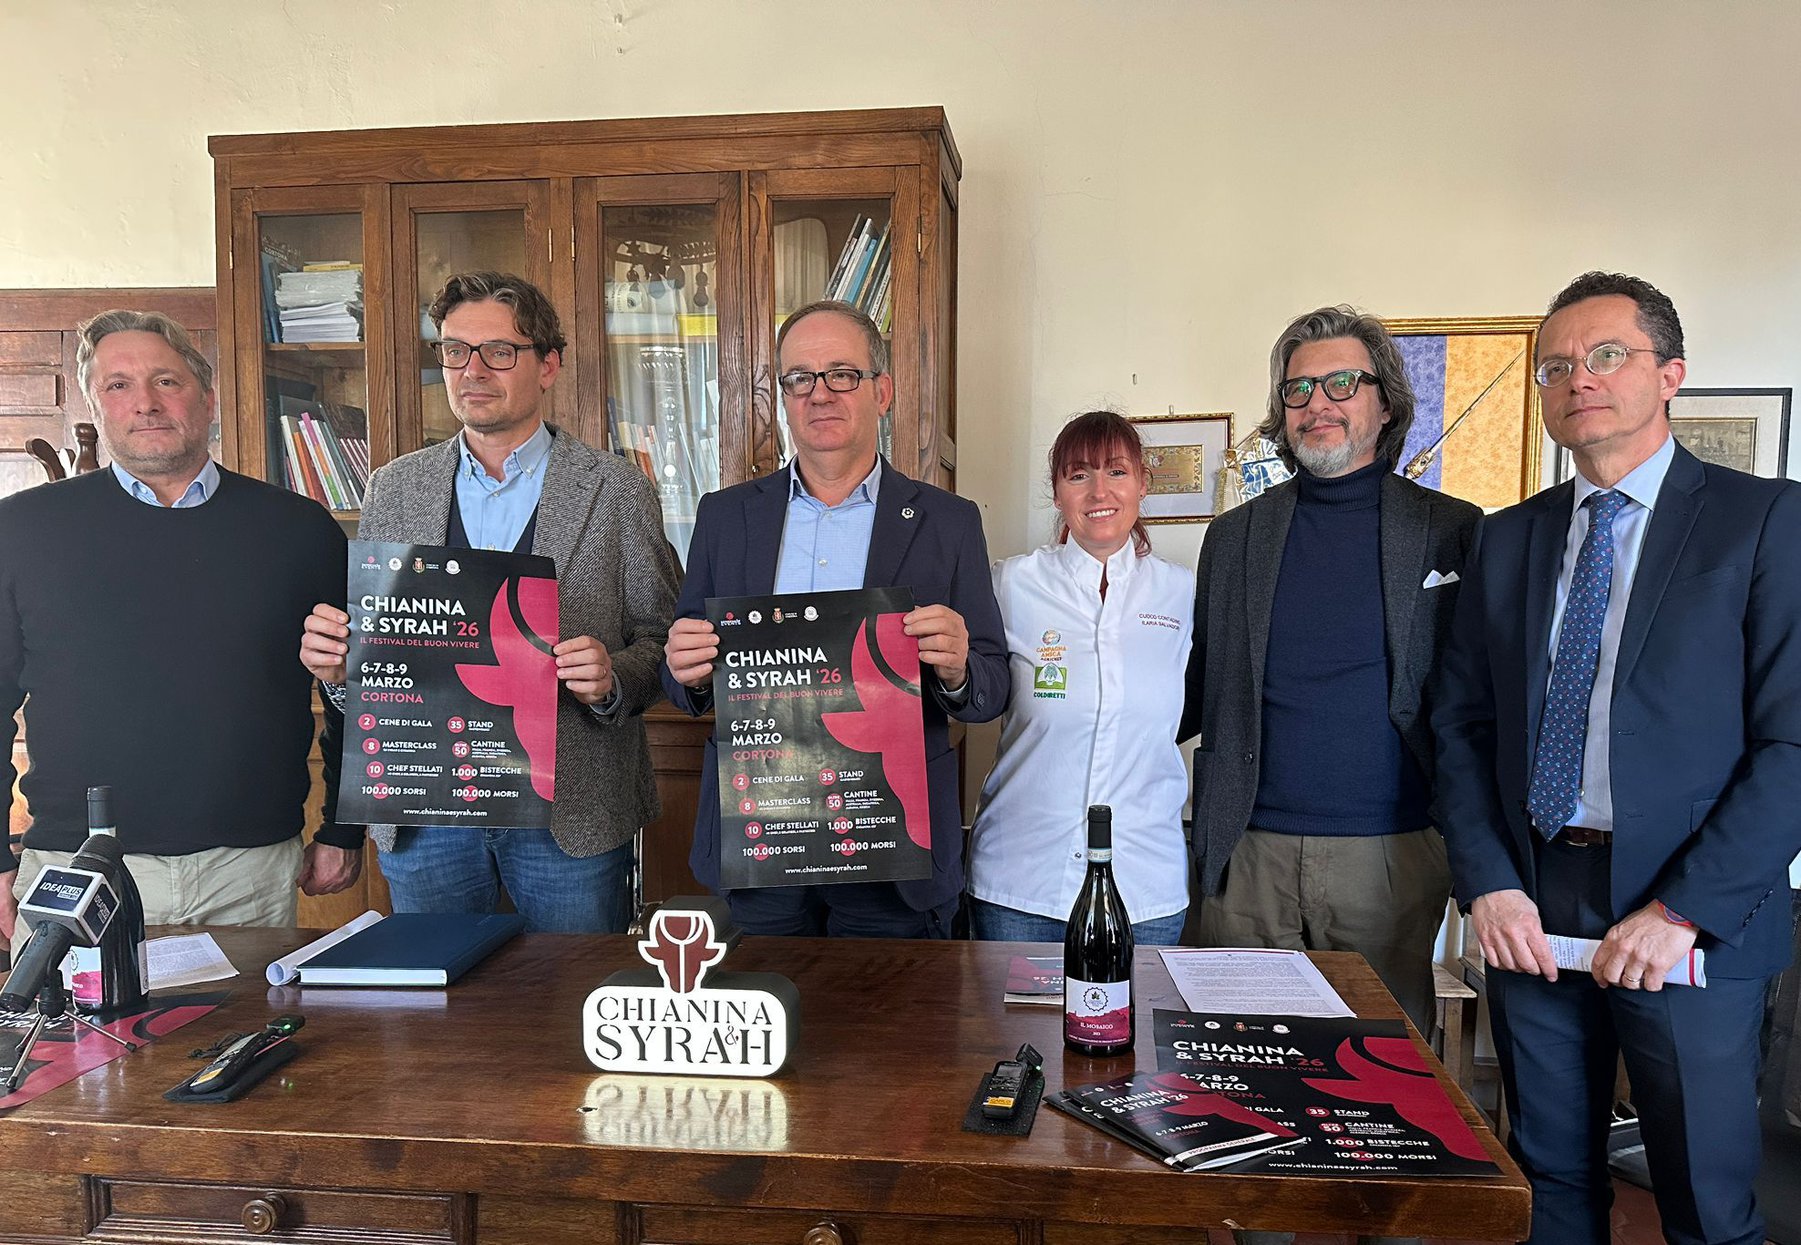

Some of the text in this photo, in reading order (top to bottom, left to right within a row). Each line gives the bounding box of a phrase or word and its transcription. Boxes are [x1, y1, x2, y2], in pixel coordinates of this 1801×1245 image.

[360, 595, 466, 616] CHIANINA
[361, 617, 479, 637] & SYRAH '26
[360, 637, 479, 649] IL FESTIVAL DEL BUON VIVERE
[1036, 645, 1066, 653] CAMPAGNA
[725, 646, 828, 668] CHIANINA
[361, 662, 407, 674] 6-7-8-9
[361, 676, 414, 689] MARZO
[727, 667, 842, 689] & SYRAH '26
[361, 691, 424, 704] CORTONA
[728, 688, 843, 702] IL FESTIVAL DEL BUON VIVERE
[1033, 691, 1066, 699] COLDIRETTI
[364, 717, 370, 726] 2
[379, 718, 432, 728] CENE DI GALA
[450, 721, 462, 729] 35
[730, 718, 775, 732] 6-7-8-9
[732, 732, 783, 748] MARZO
[368, 741, 375, 750] 8
[382, 741, 437, 750] MASTERCLASS
[454, 746, 467, 755] 50
[732, 749, 794, 762] CORTONA
[369, 765, 381, 774] 10
[409, 765, 443, 773] STELLATI
[451, 768, 478, 777] 1.000
[480, 766, 522, 775] BISTECCHE
[839, 770, 864, 778] STAND
[738, 777, 744, 786] 2
[752, 776, 774, 784] CENE
[783, 775, 805, 783] GALA
[821, 772, 833, 781] 35
[361, 785, 427, 796] 100.000 SORSI
[452, 788, 519, 799] 100.000 MORSI
[843, 790, 878, 798] CANTINE
[744, 802, 751, 811] 8
[758, 797, 811, 807] MASTERCLASS
[828, 800, 841, 808] 50
[403, 808, 488, 818] www.chianinaesyrah.com
[786, 821, 819, 830] STELLATI
[827, 821, 853, 830] 1.000
[855, 816, 897, 825] BISTECCHE
[747, 826, 759, 835] 10
[742, 845, 806, 857] 100.000 SORSI
[830, 841, 896, 852] 100.000 MORSI
[785, 863, 868, 875] www.chianinaesyrah.com
[39, 881, 82, 895] IDEA PLUS
[596, 996, 773, 1026] CHIANINA
[724, 1025, 739, 1046] &
[596, 1023, 772, 1066] SYRAH
[1172, 1041, 1305, 1057] CHIANINA
[1175, 1051, 1193, 1060] &
[1199, 1052, 1285, 1065] SYRAH
[1200, 1081, 1249, 1091] ARZO
[1100, 1090, 1171, 1107] CHIANINA
[1111, 1106, 1126, 1114] &
[1123, 1097, 1171, 1111] SYRAH
[1181, 1121, 1209, 1130] MARZO
[1325, 1138, 1365, 1146] 1.000
[1366, 1139, 1430, 1147] BISTECCHE
[1334, 1152, 1394, 1160] 100.000
